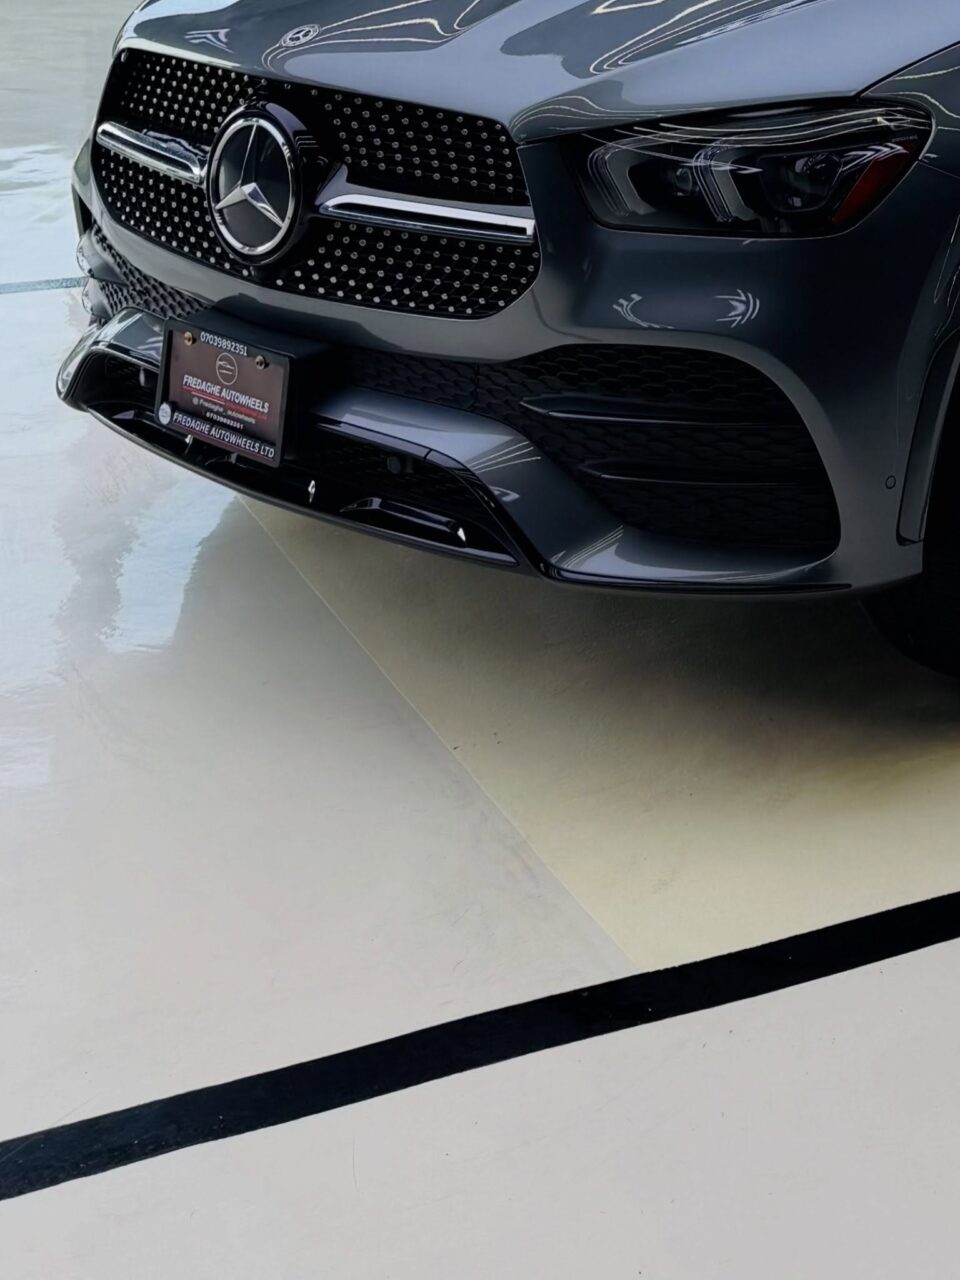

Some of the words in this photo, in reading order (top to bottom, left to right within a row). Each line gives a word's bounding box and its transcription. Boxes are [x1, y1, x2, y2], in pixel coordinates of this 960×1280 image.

[200, 331, 248, 356] 07039892351
[182, 375, 221, 397] FREDAGHE
[220, 388, 270, 413] AUTOWHEELS
[173, 412, 211, 434] FREDAGHE
[210, 427, 259, 453] AUTOWHEELS
[259, 444, 275, 458] LTD
